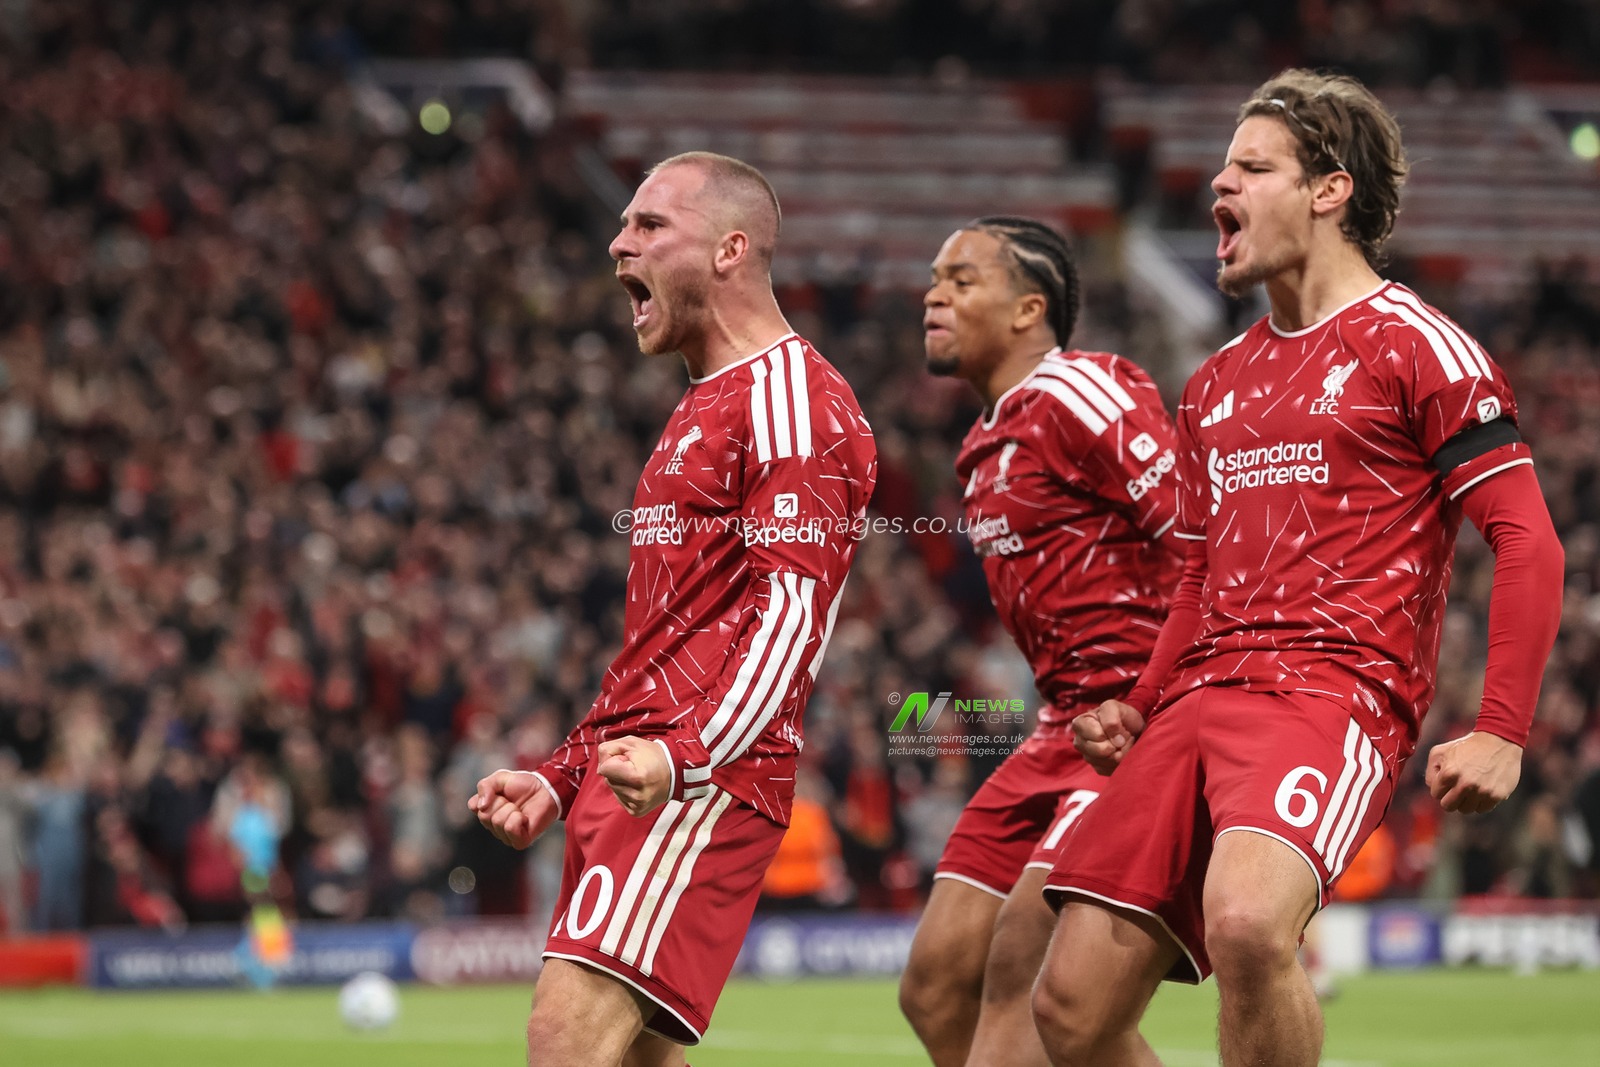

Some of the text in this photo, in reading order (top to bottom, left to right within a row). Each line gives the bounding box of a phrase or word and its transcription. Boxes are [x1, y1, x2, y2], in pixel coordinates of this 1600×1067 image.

[1226, 439, 1323, 473] standard
[1224, 462, 1329, 494] chartered
[1274, 765, 1328, 828] 6
